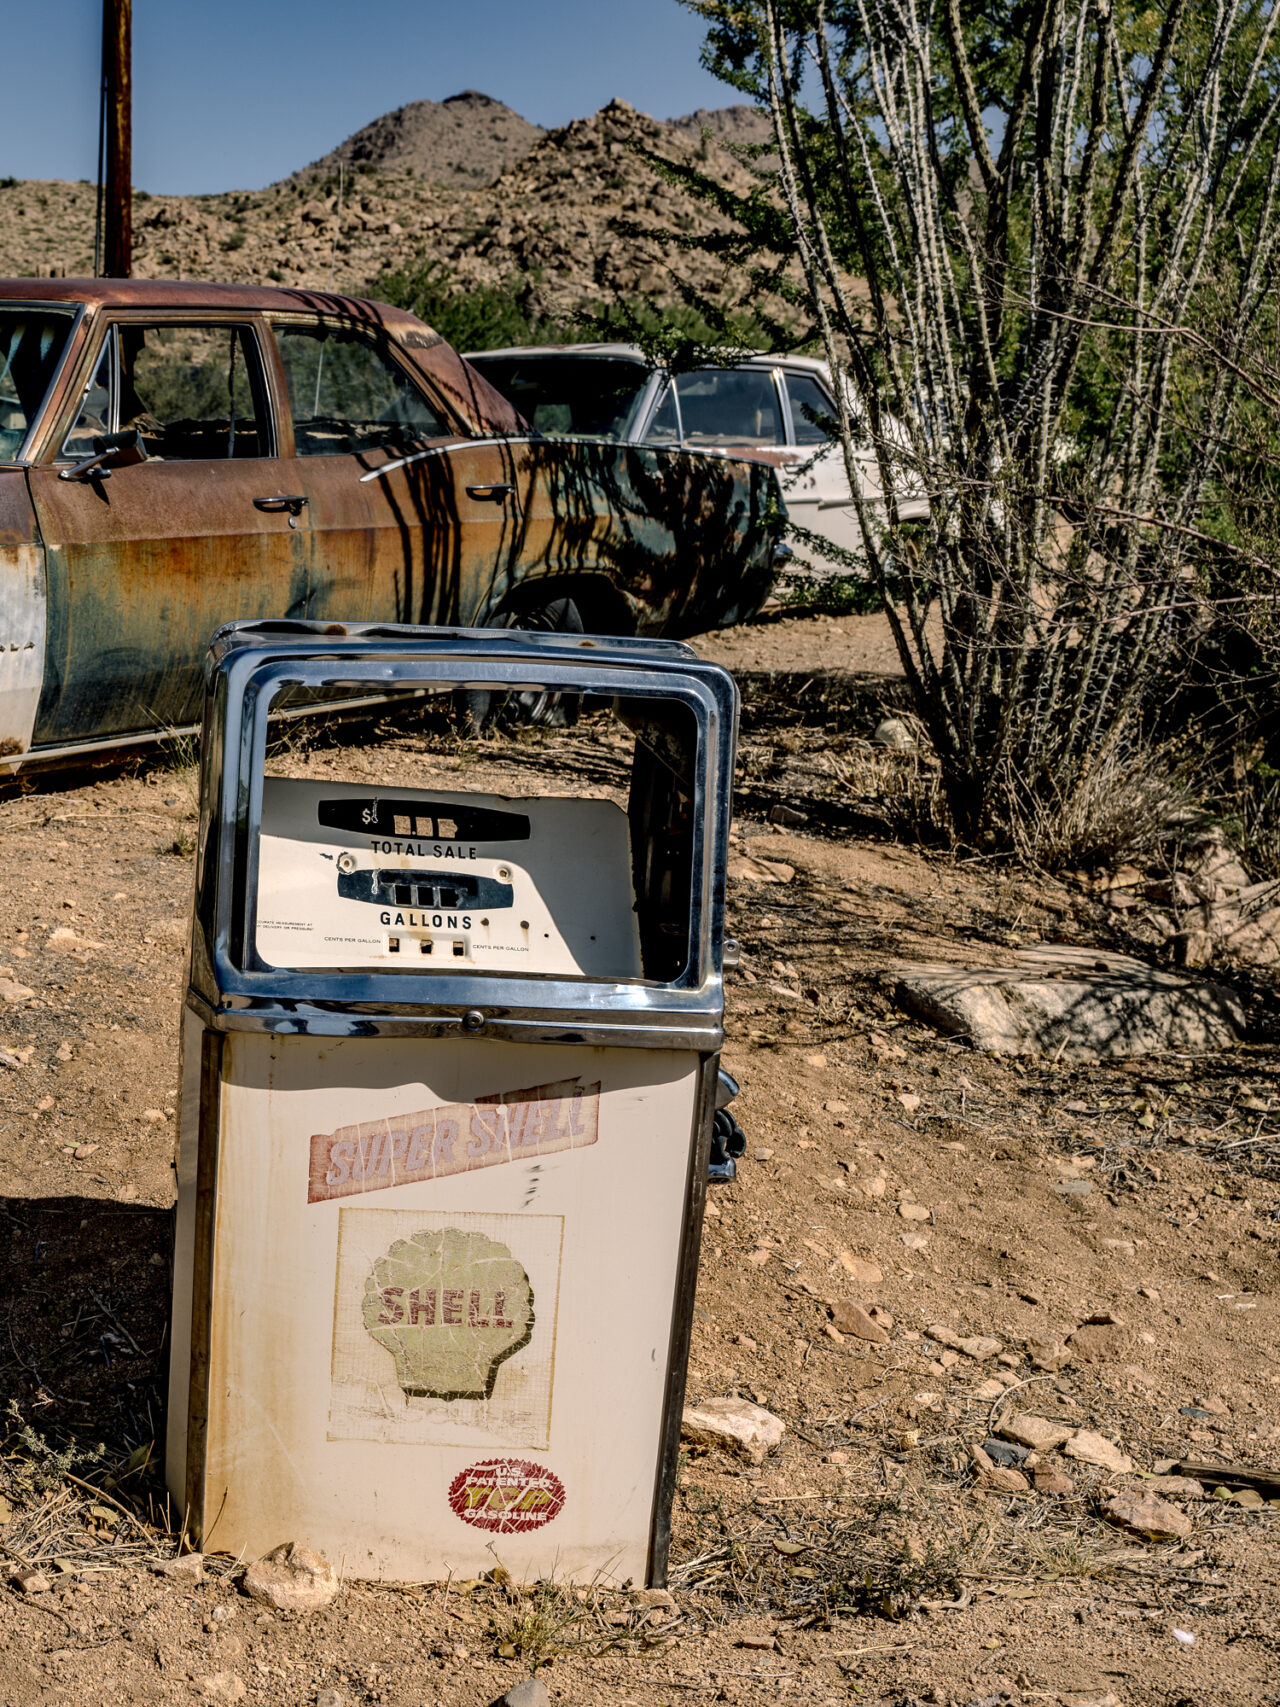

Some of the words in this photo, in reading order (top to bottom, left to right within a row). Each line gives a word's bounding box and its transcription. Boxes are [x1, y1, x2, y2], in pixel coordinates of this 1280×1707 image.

[362, 808, 371, 825] $
[371, 841, 425, 857] TOTAL
[433, 845, 477, 860] SALE
[380, 911, 472, 930] GALLONS
[326, 1118, 459, 1186] SUPER
[467, 1089, 586, 1158] SHELL
[377, 1286, 514, 1329] SHELL
[464, 1486, 552, 1510] TCP
[464, 1509, 547, 1521] GASOLINE
